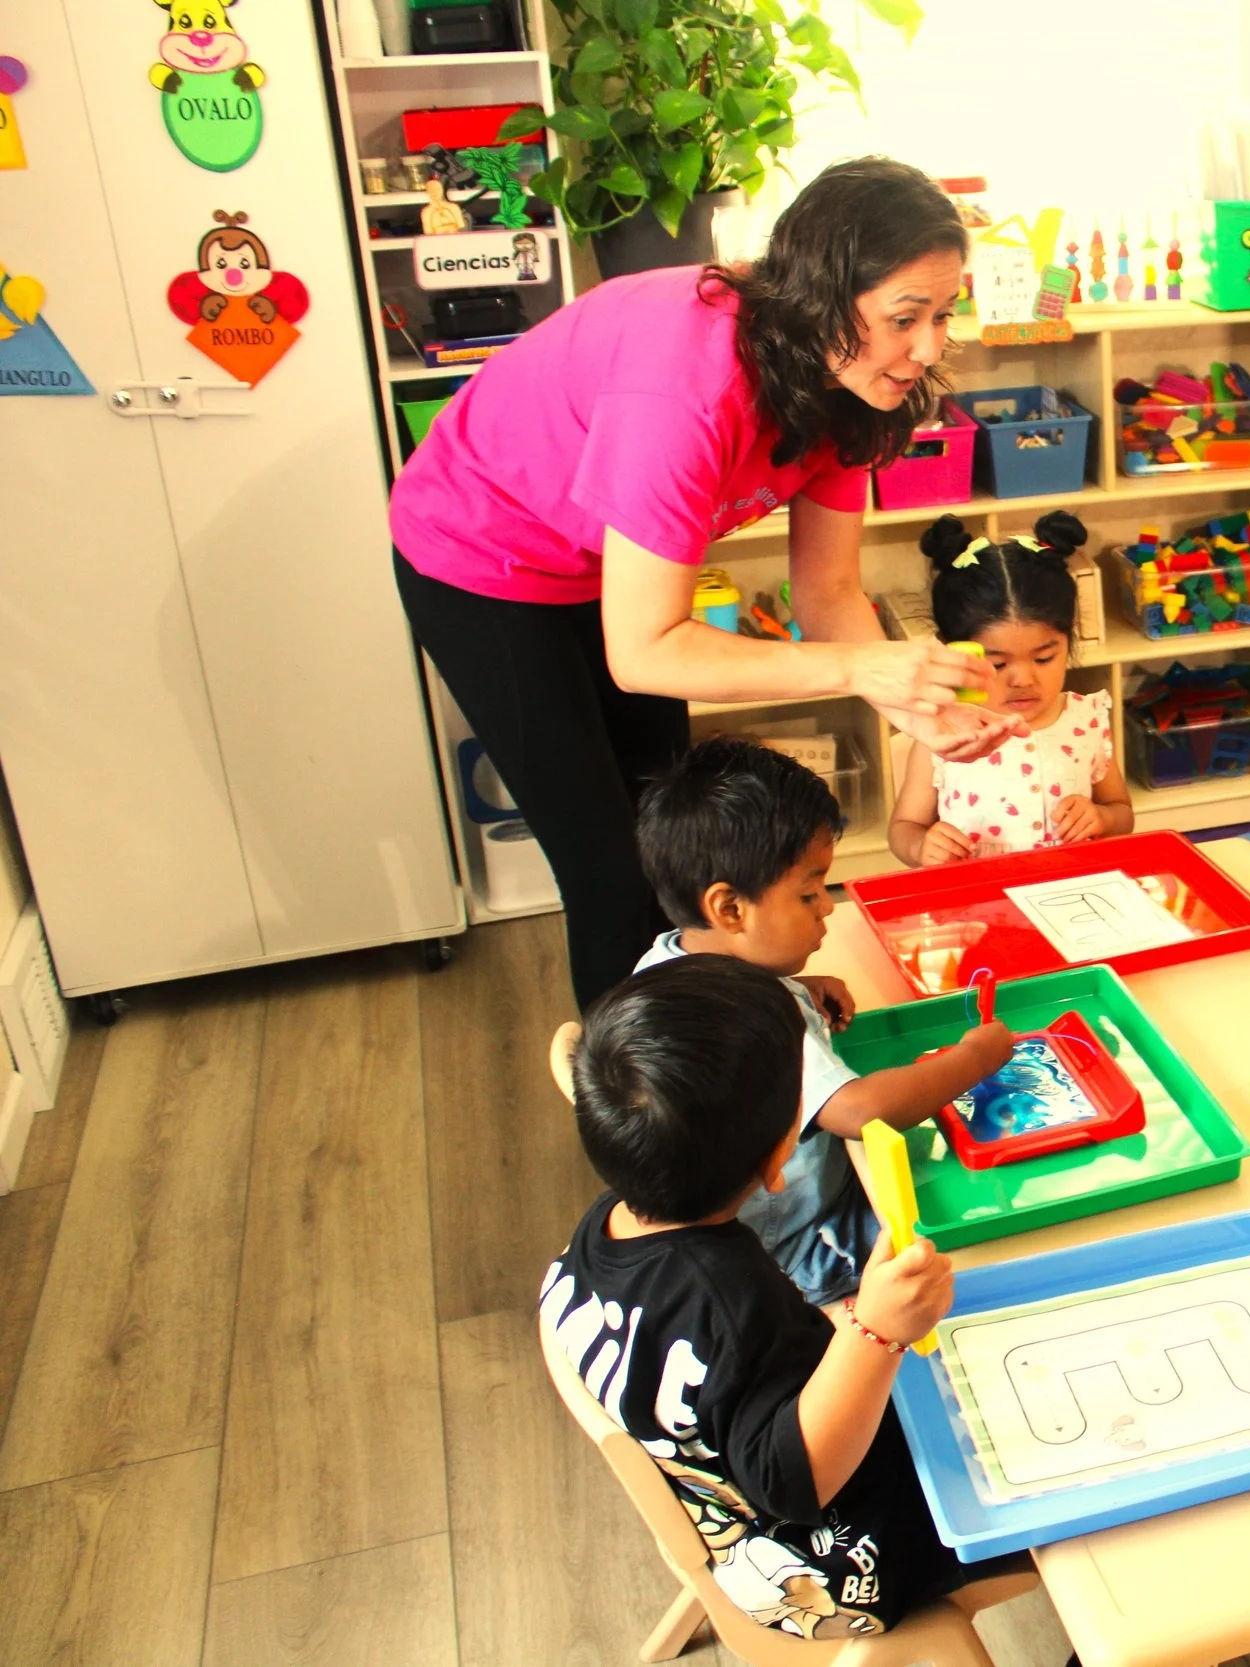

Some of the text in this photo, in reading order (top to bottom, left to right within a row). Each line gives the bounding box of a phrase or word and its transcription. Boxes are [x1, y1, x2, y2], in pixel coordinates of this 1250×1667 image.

[178, 97, 253, 121] OVALO
[423, 254, 511, 272] Ciencias
[211, 328, 275, 346] ROMBO
[0, 369, 71, 387] IANGULO
